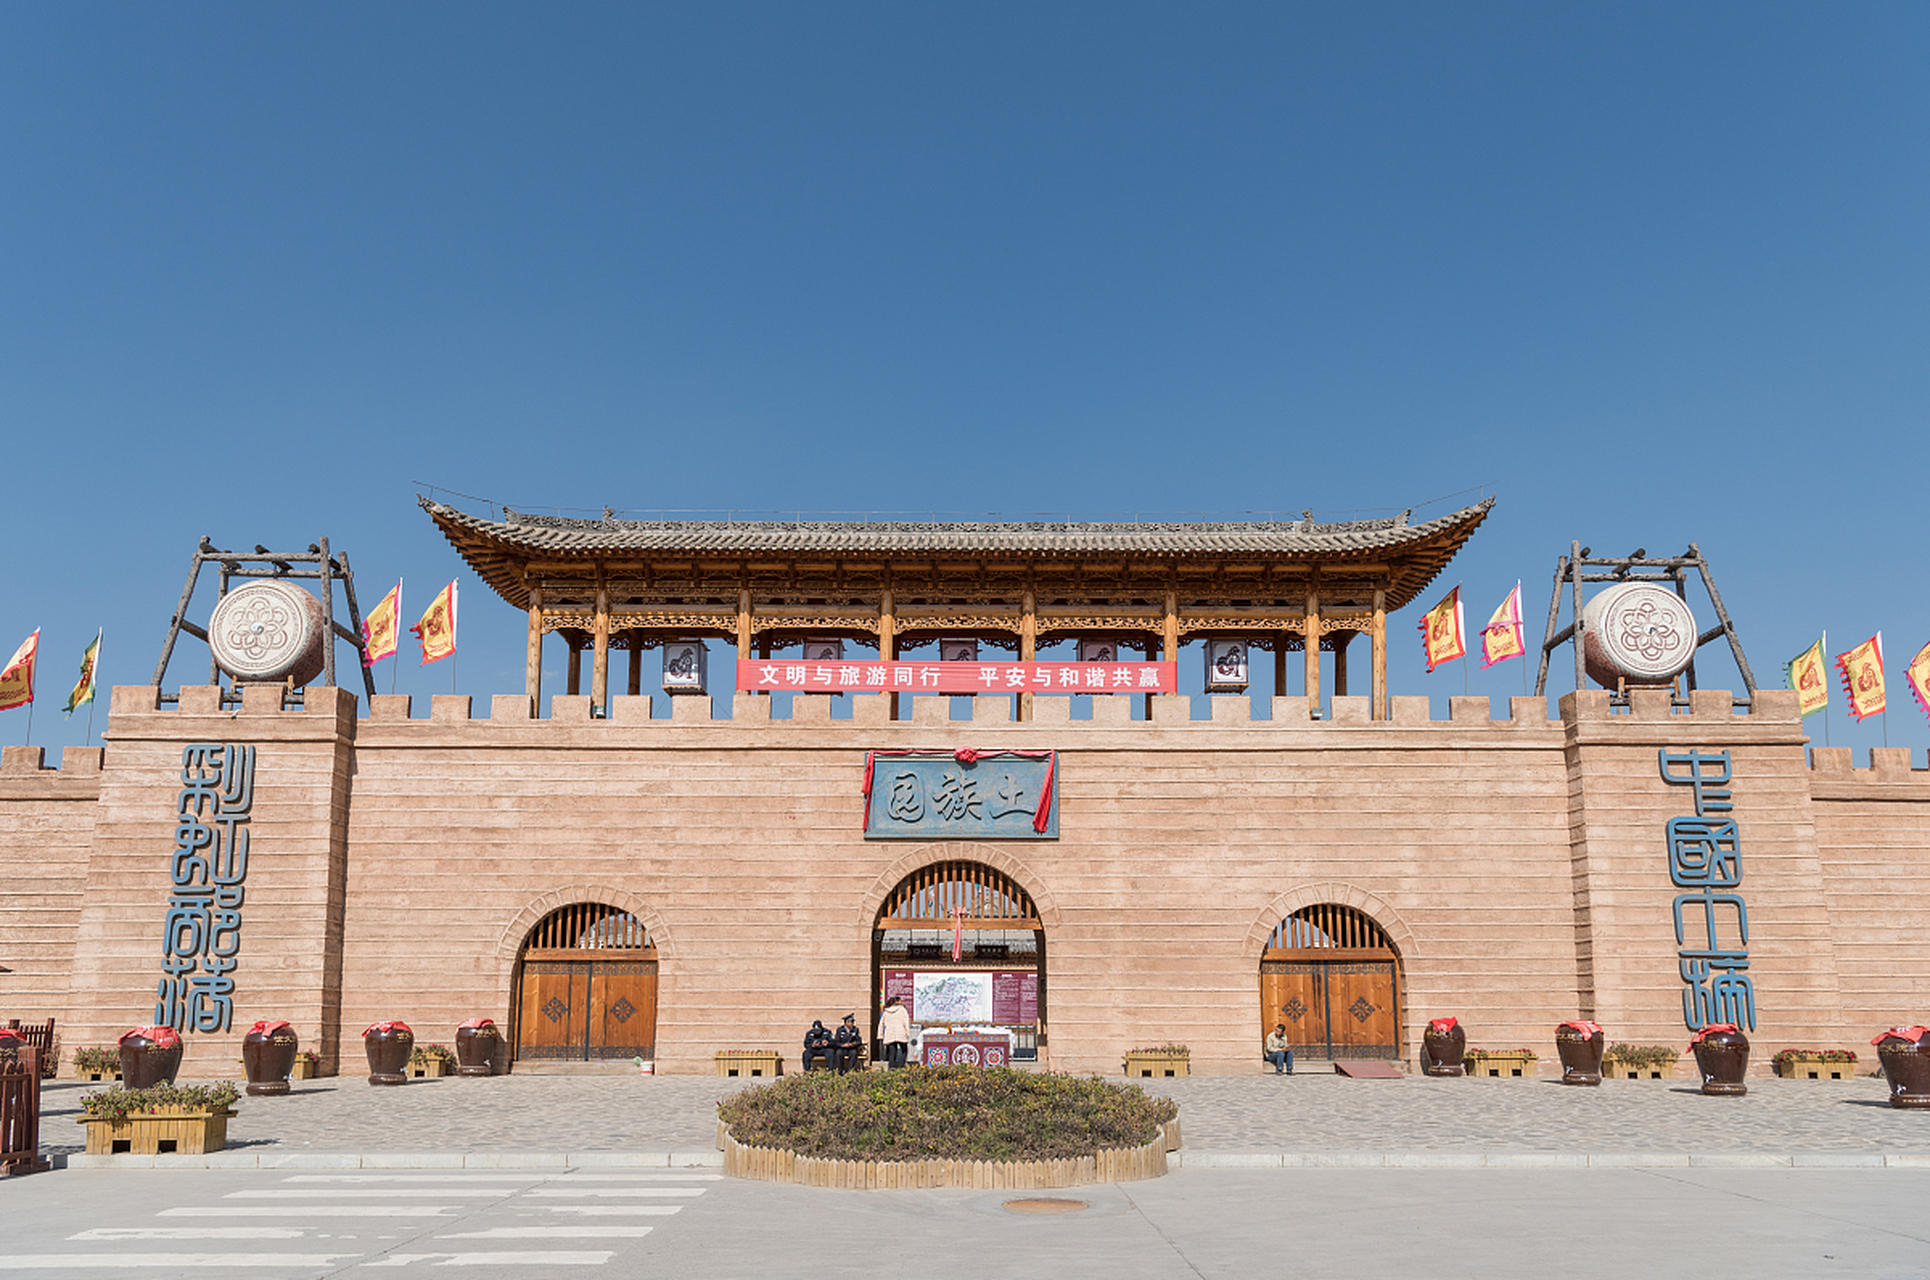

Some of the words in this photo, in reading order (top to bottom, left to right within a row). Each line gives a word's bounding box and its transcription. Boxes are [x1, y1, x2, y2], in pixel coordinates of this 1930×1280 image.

[759, 664, 943, 687] 文明与旅游同行
[978, 666, 1161, 689] 平安与和谐共赢
